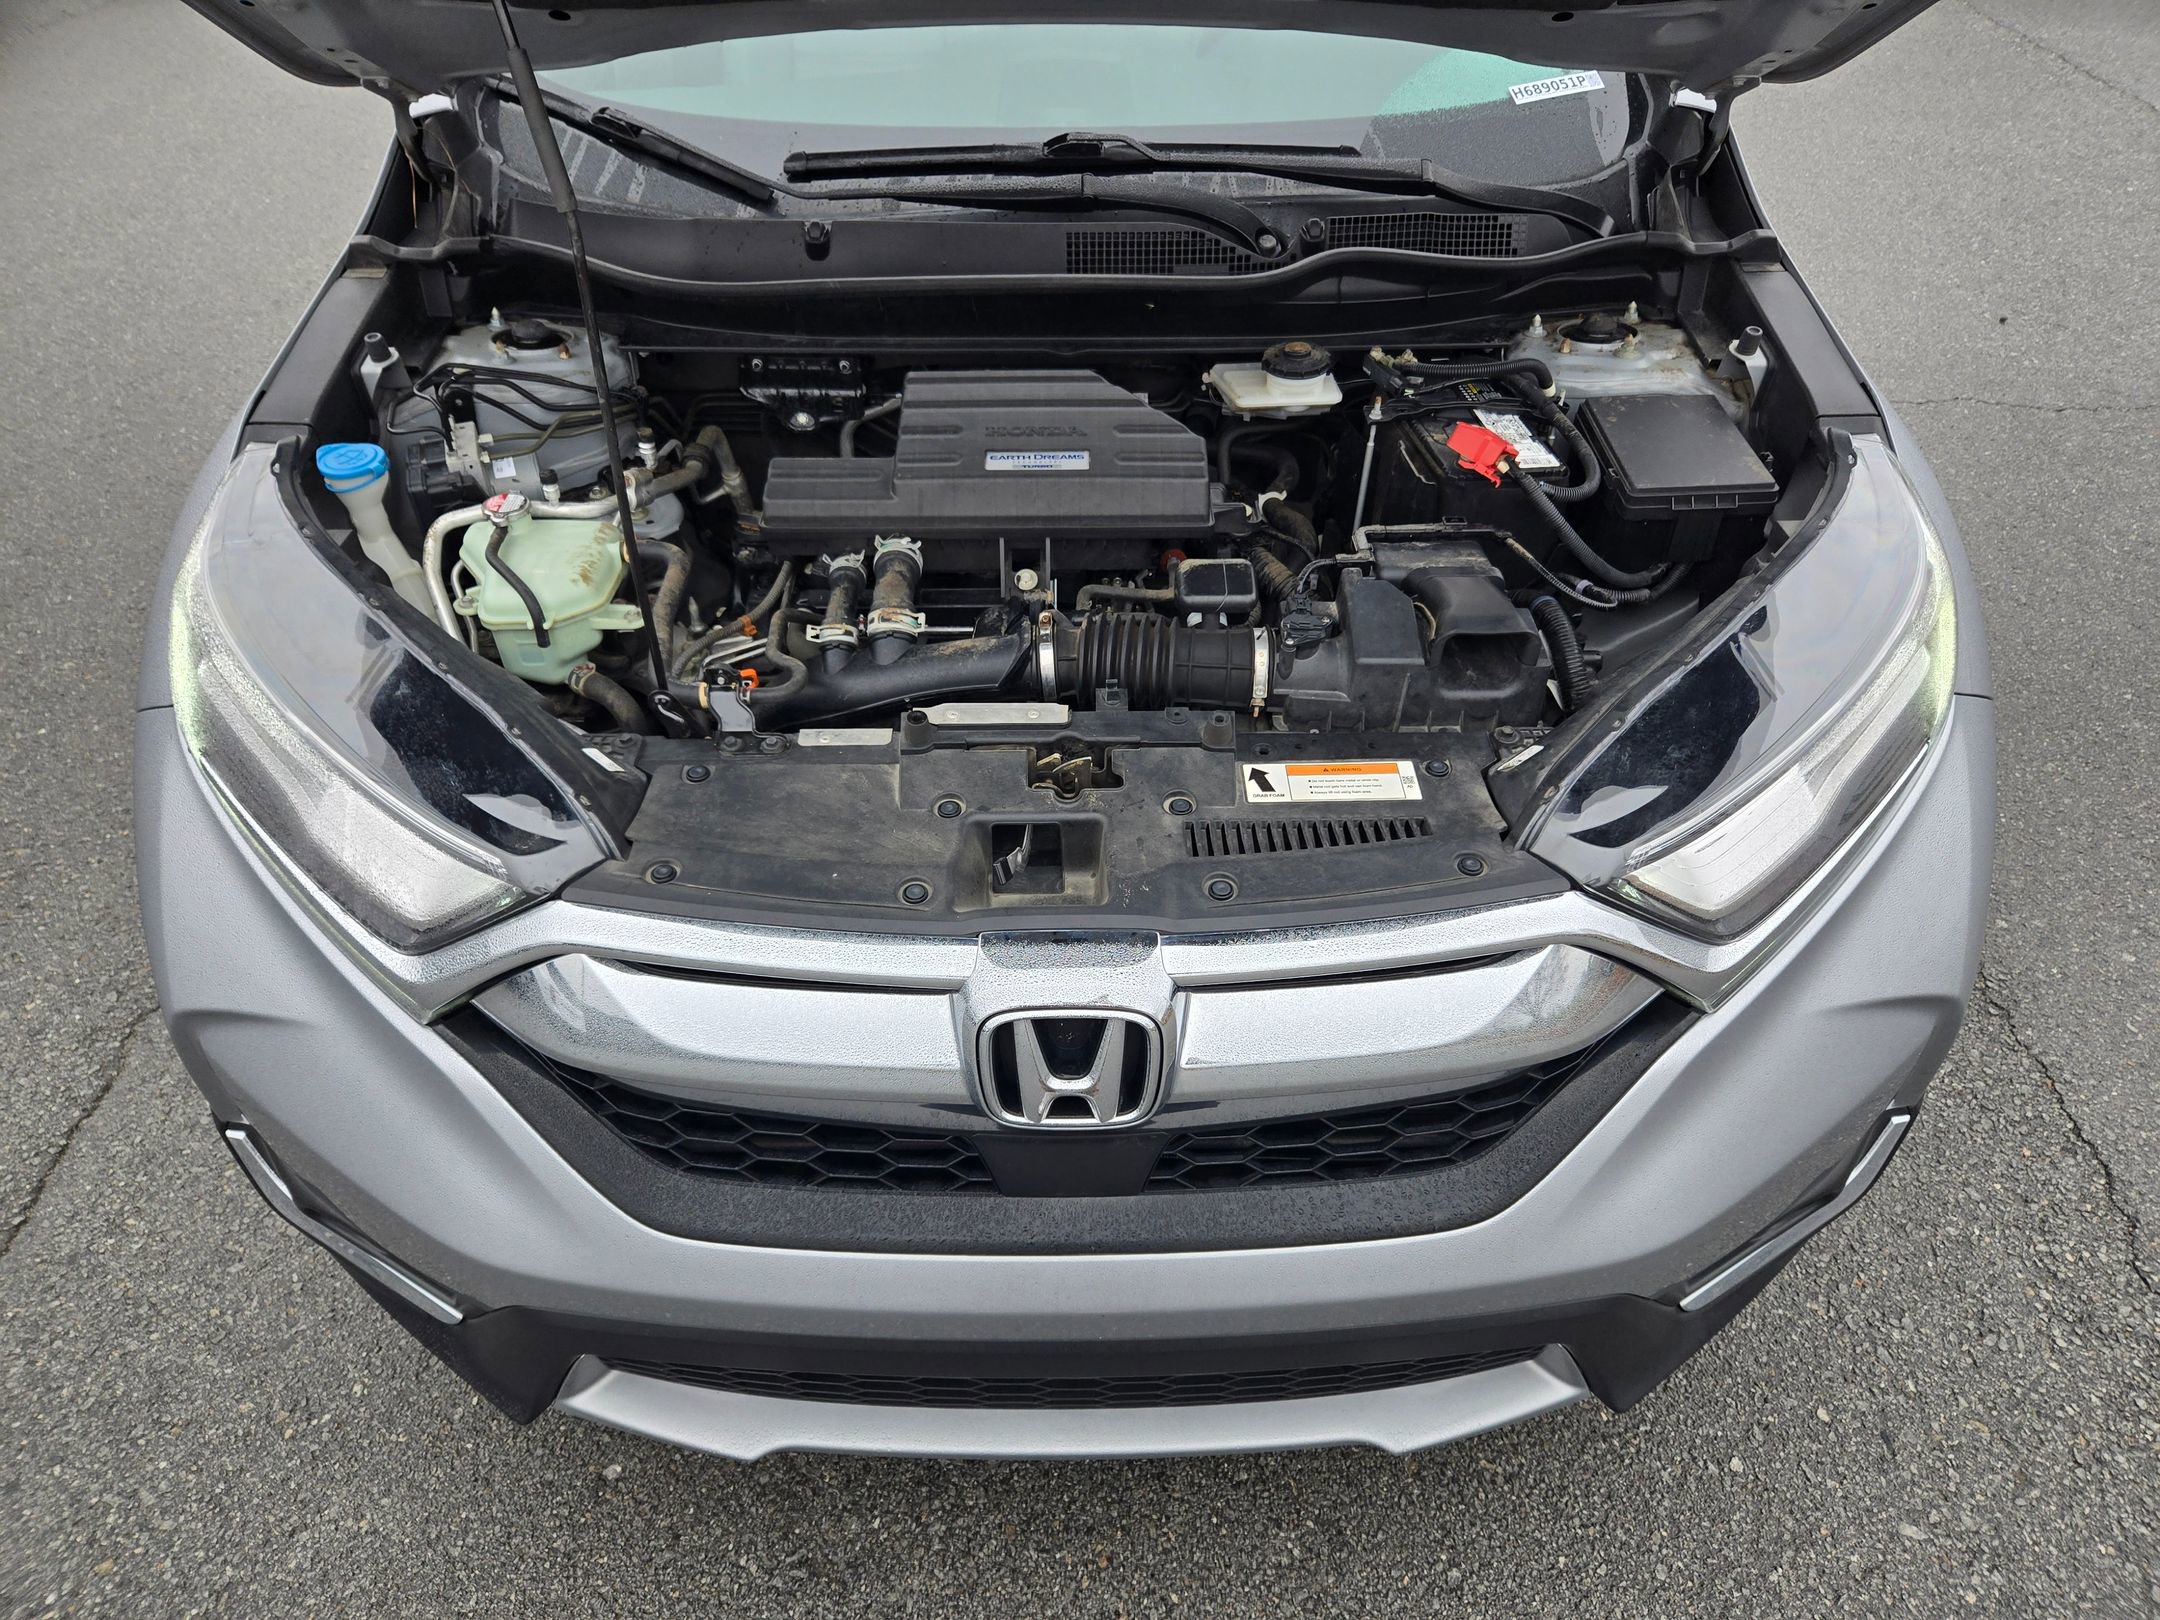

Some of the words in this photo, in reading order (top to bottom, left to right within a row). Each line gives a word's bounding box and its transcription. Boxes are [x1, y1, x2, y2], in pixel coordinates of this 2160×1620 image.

[1511, 75, 1586, 100] H689051P
[985, 426, 1088, 438] HONDA
[1033, 453, 1085, 461] DREAMS
